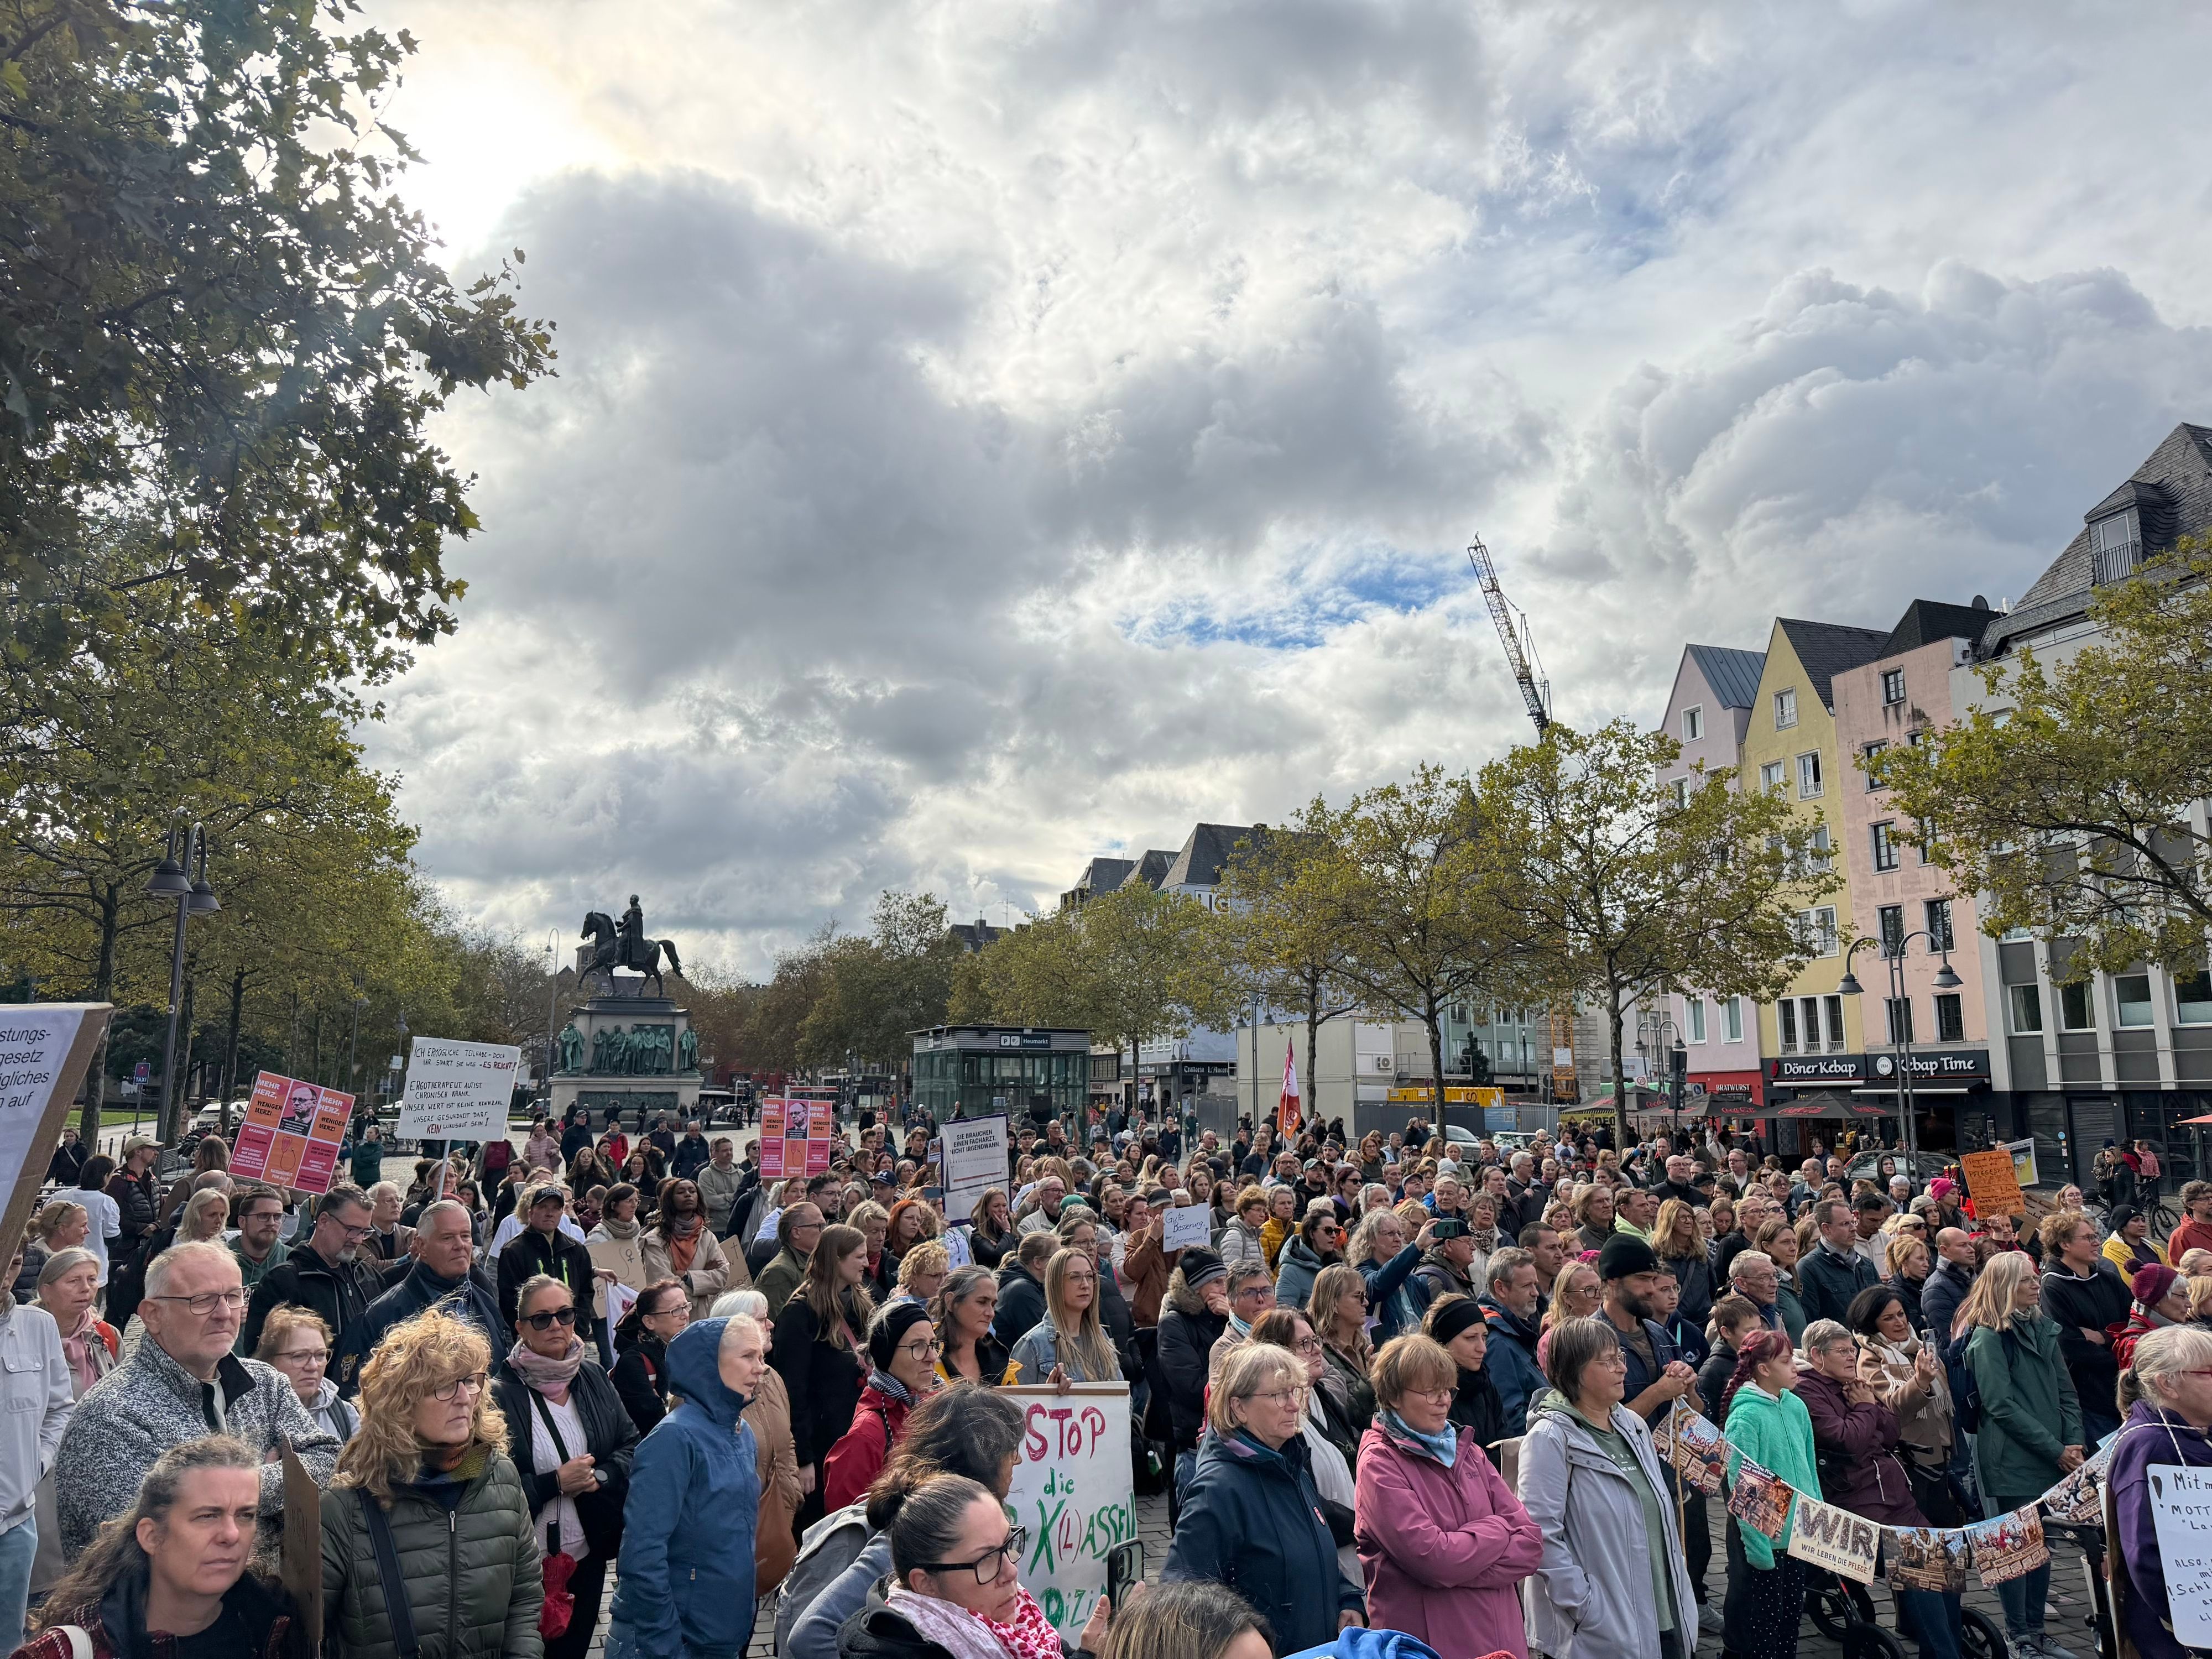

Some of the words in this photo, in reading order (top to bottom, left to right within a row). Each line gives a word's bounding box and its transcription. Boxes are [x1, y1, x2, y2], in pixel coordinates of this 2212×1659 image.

[1784, 1062, 1818, 1074] Döner
[1819, 1060, 1856, 1078] Kebap
[1940, 1056, 1975, 1071] Time
[257, 1079, 280, 1089] MEHR
[8, 1092, 34, 1107] auf
[257, 1100, 283, 1110] WENIGER
[322, 1097, 343, 1107] MEHR
[405, 1103, 425, 1112] UNSER
[321, 1116, 346, 1126] WENIGER
[426, 1123, 441, 1134] KEIN
[966, 1129, 993, 1139] BRAUCHEN
[1166, 1212, 1185, 1224] Gute
[1026, 1402, 1106, 1462] STOP
[1044, 1467, 1074, 1497] die
[2173, 1473, 2200, 1490] Mit
[1801, 1502, 1875, 1561] WIR
[1801, 1543, 1814, 1554] WIR
[1817, 1549, 1837, 1562] LEBEN
[1838, 1557, 1847, 1566] DIE
